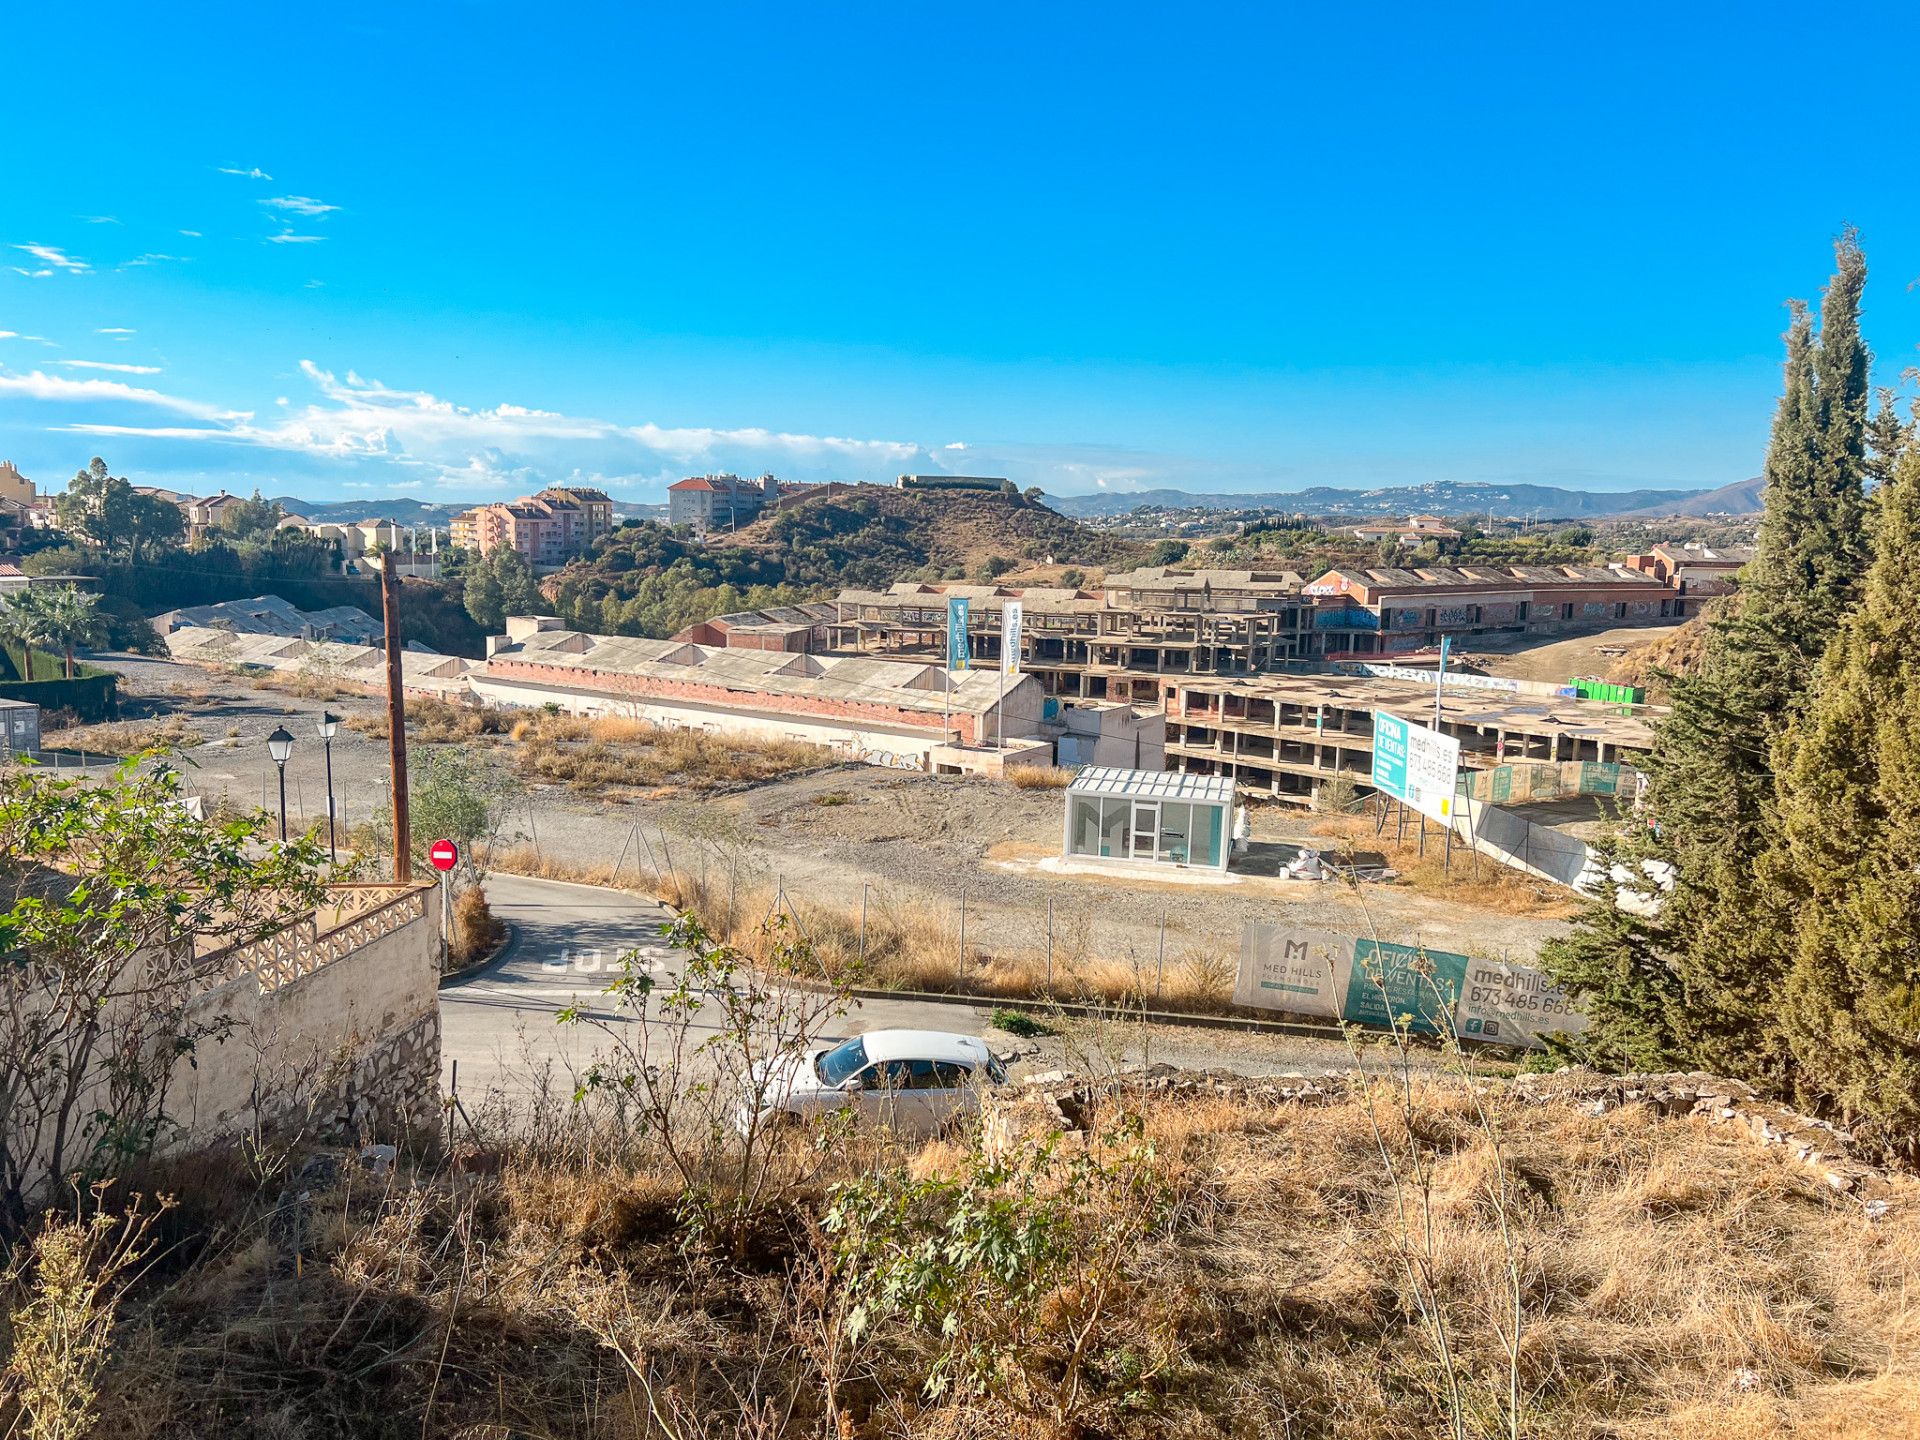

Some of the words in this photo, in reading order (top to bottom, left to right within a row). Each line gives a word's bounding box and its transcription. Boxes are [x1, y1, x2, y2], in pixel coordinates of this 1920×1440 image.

[955, 604, 965, 658] medhills.es
[541, 945, 665, 973] STOP
[1263, 963, 1287, 974] MED
[1291, 967, 1322, 978] HILLS
[1474, 969, 1567, 995] medhills.e
[1360, 1002, 1385, 1010] SALIDA
[1471, 986, 1501, 1006] 673
[1505, 992, 1539, 1010] 485
[1468, 1003, 1550, 1025] info@medhills.es
